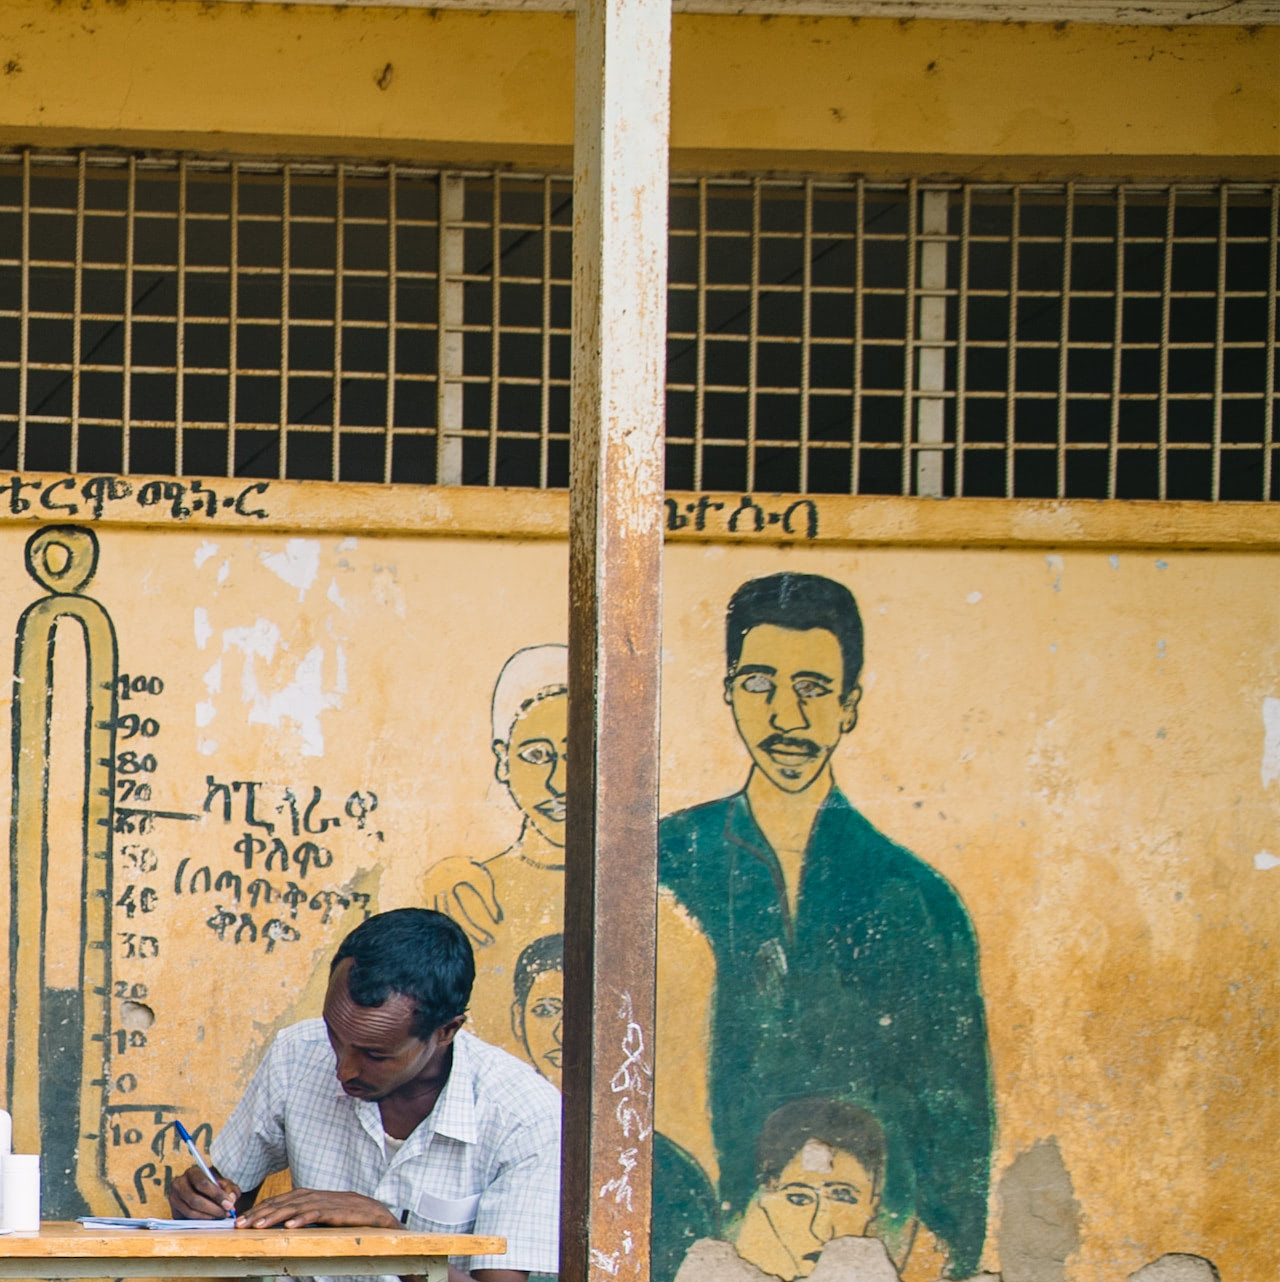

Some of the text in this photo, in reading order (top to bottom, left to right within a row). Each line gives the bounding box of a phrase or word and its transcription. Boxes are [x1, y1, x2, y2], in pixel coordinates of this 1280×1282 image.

[118, 673, 164, 700] 100
[118, 713, 160, 740] 90
[117, 751, 158, 775] 80
[117, 779, 152, 802] 70
[116, 884, 159, 918] 40
[117, 932, 159, 959] 30
[114, 980, 148, 1000] 20
[113, 1029, 148, 1055] 10
[116, 1072, 138, 1094] 0
